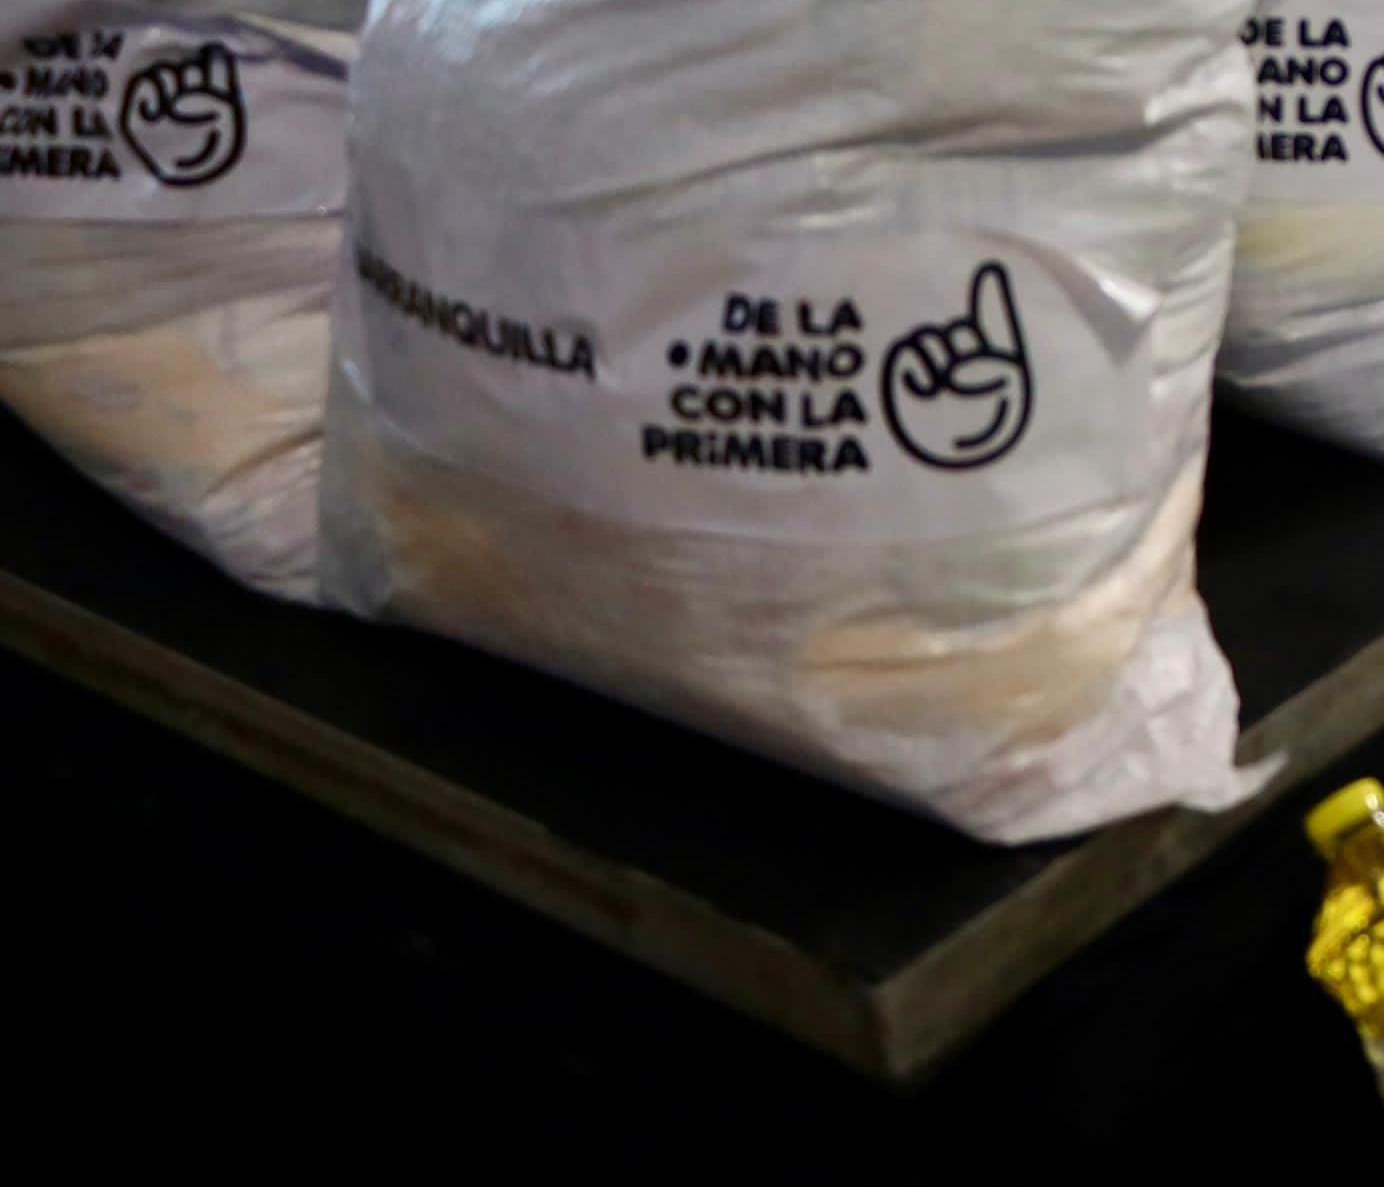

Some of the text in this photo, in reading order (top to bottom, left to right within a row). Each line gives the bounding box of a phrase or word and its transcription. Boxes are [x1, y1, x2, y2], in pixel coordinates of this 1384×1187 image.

[1298, 18, 1348, 47] LA
[1257, 57, 1348, 85] ANO
[1298, 95, 1348, 123] LA
[723, 291, 863, 337] DE LA
[699, 339, 865, 383] MANO
[671, 383, 868, 429] CON LA
